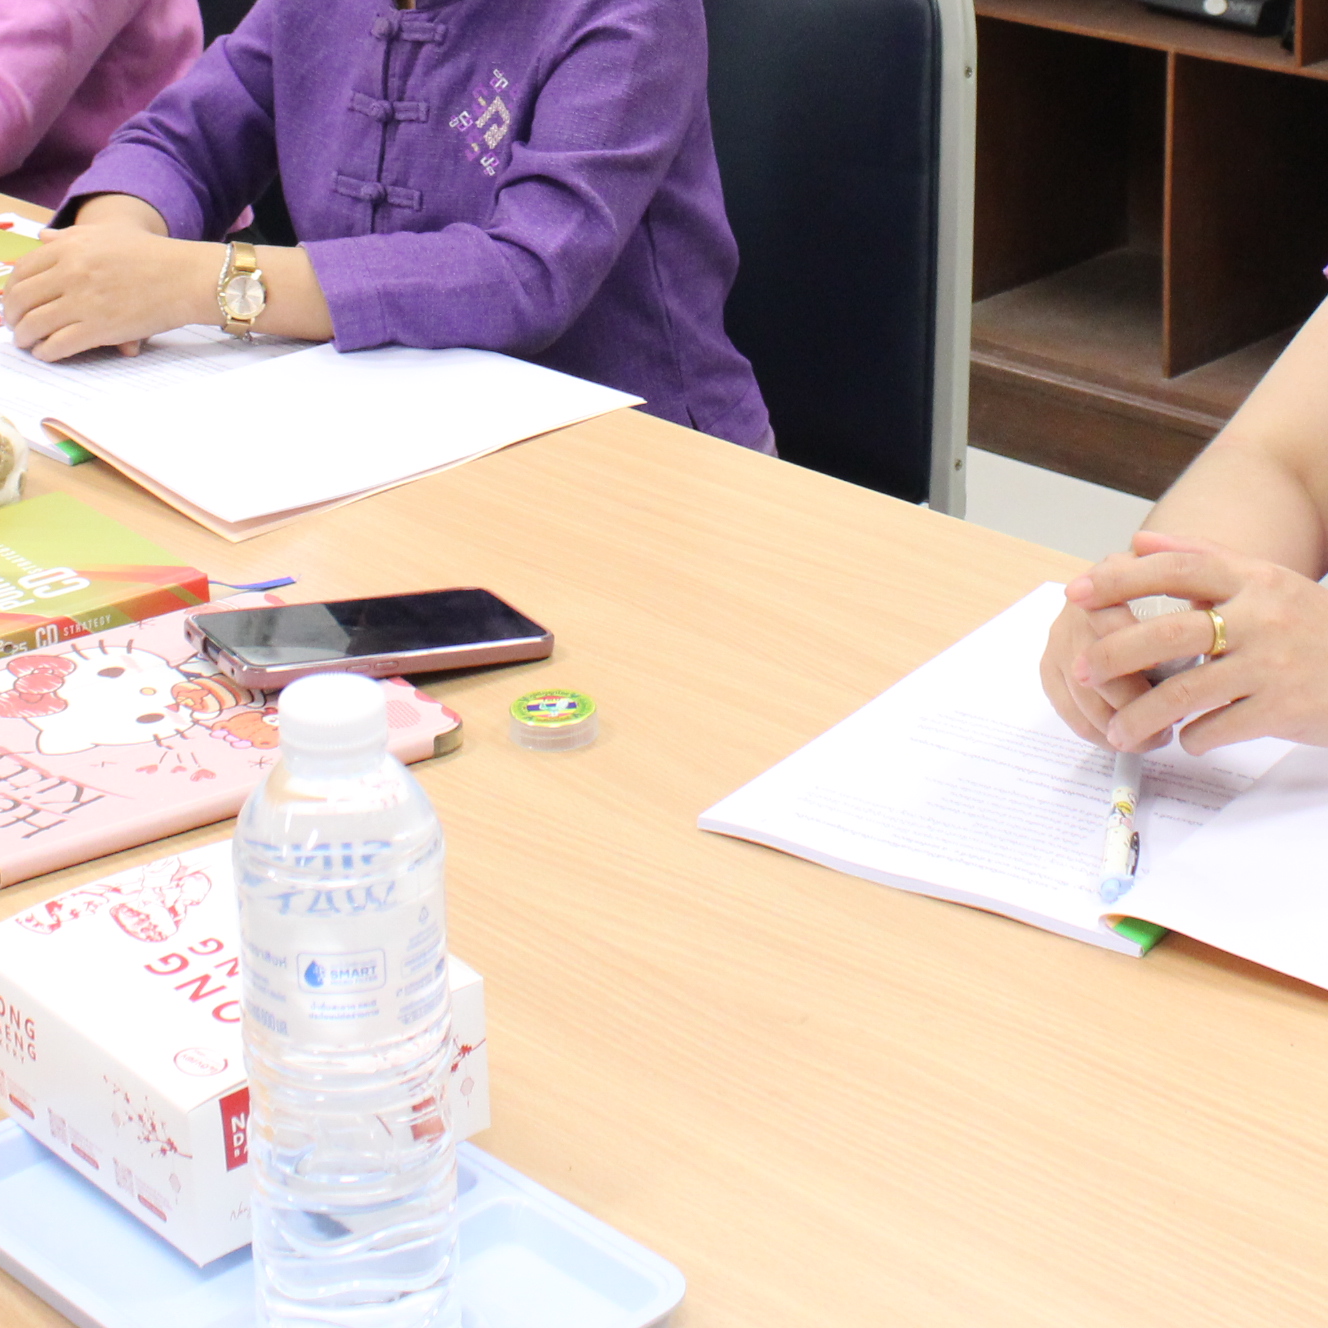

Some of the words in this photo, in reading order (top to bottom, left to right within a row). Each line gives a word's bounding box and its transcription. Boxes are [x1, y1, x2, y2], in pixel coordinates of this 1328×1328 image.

[17, 566, 92, 599] CD
[35, 623, 59, 649] CD
[63, 614, 112, 637] STRATEGY
[143, 953, 241, 1023] ONG
[330, 965, 377, 980] SMART
